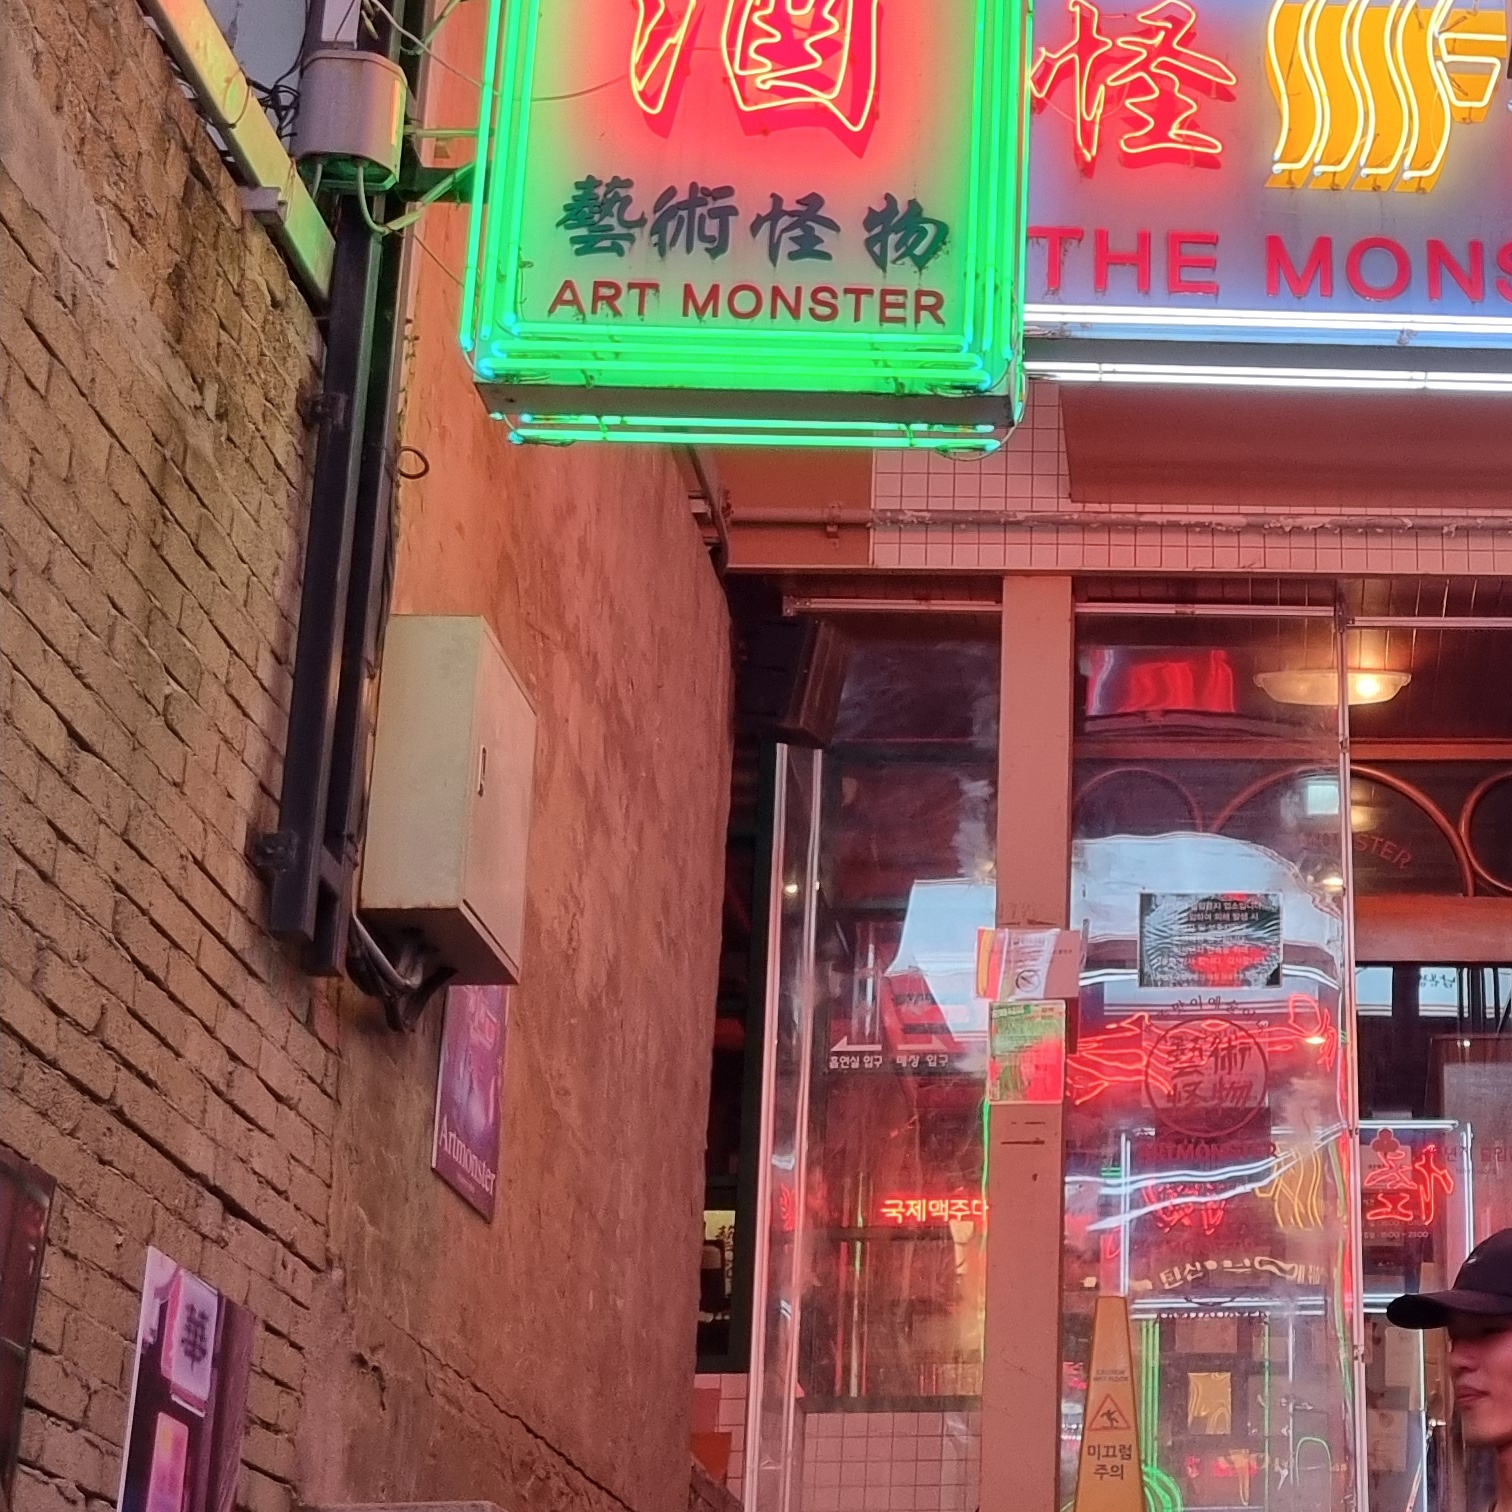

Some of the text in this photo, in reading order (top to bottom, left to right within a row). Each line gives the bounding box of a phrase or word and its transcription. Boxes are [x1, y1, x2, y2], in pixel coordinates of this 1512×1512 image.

[555, 173, 949, 271] 藝術怪物
[1027, 226, 1218, 295] THE
[548, 279, 946, 325] ART MONSTER
[828, 1055, 883, 1069] 흡연실 입구
[896, 1054, 949, 1068] 매장 입구
[438, 1114, 496, 1196] Artmonster
[1087, 1443, 1133, 1461] 미끄럼
[1093, 1463, 1124, 1480] 주의
